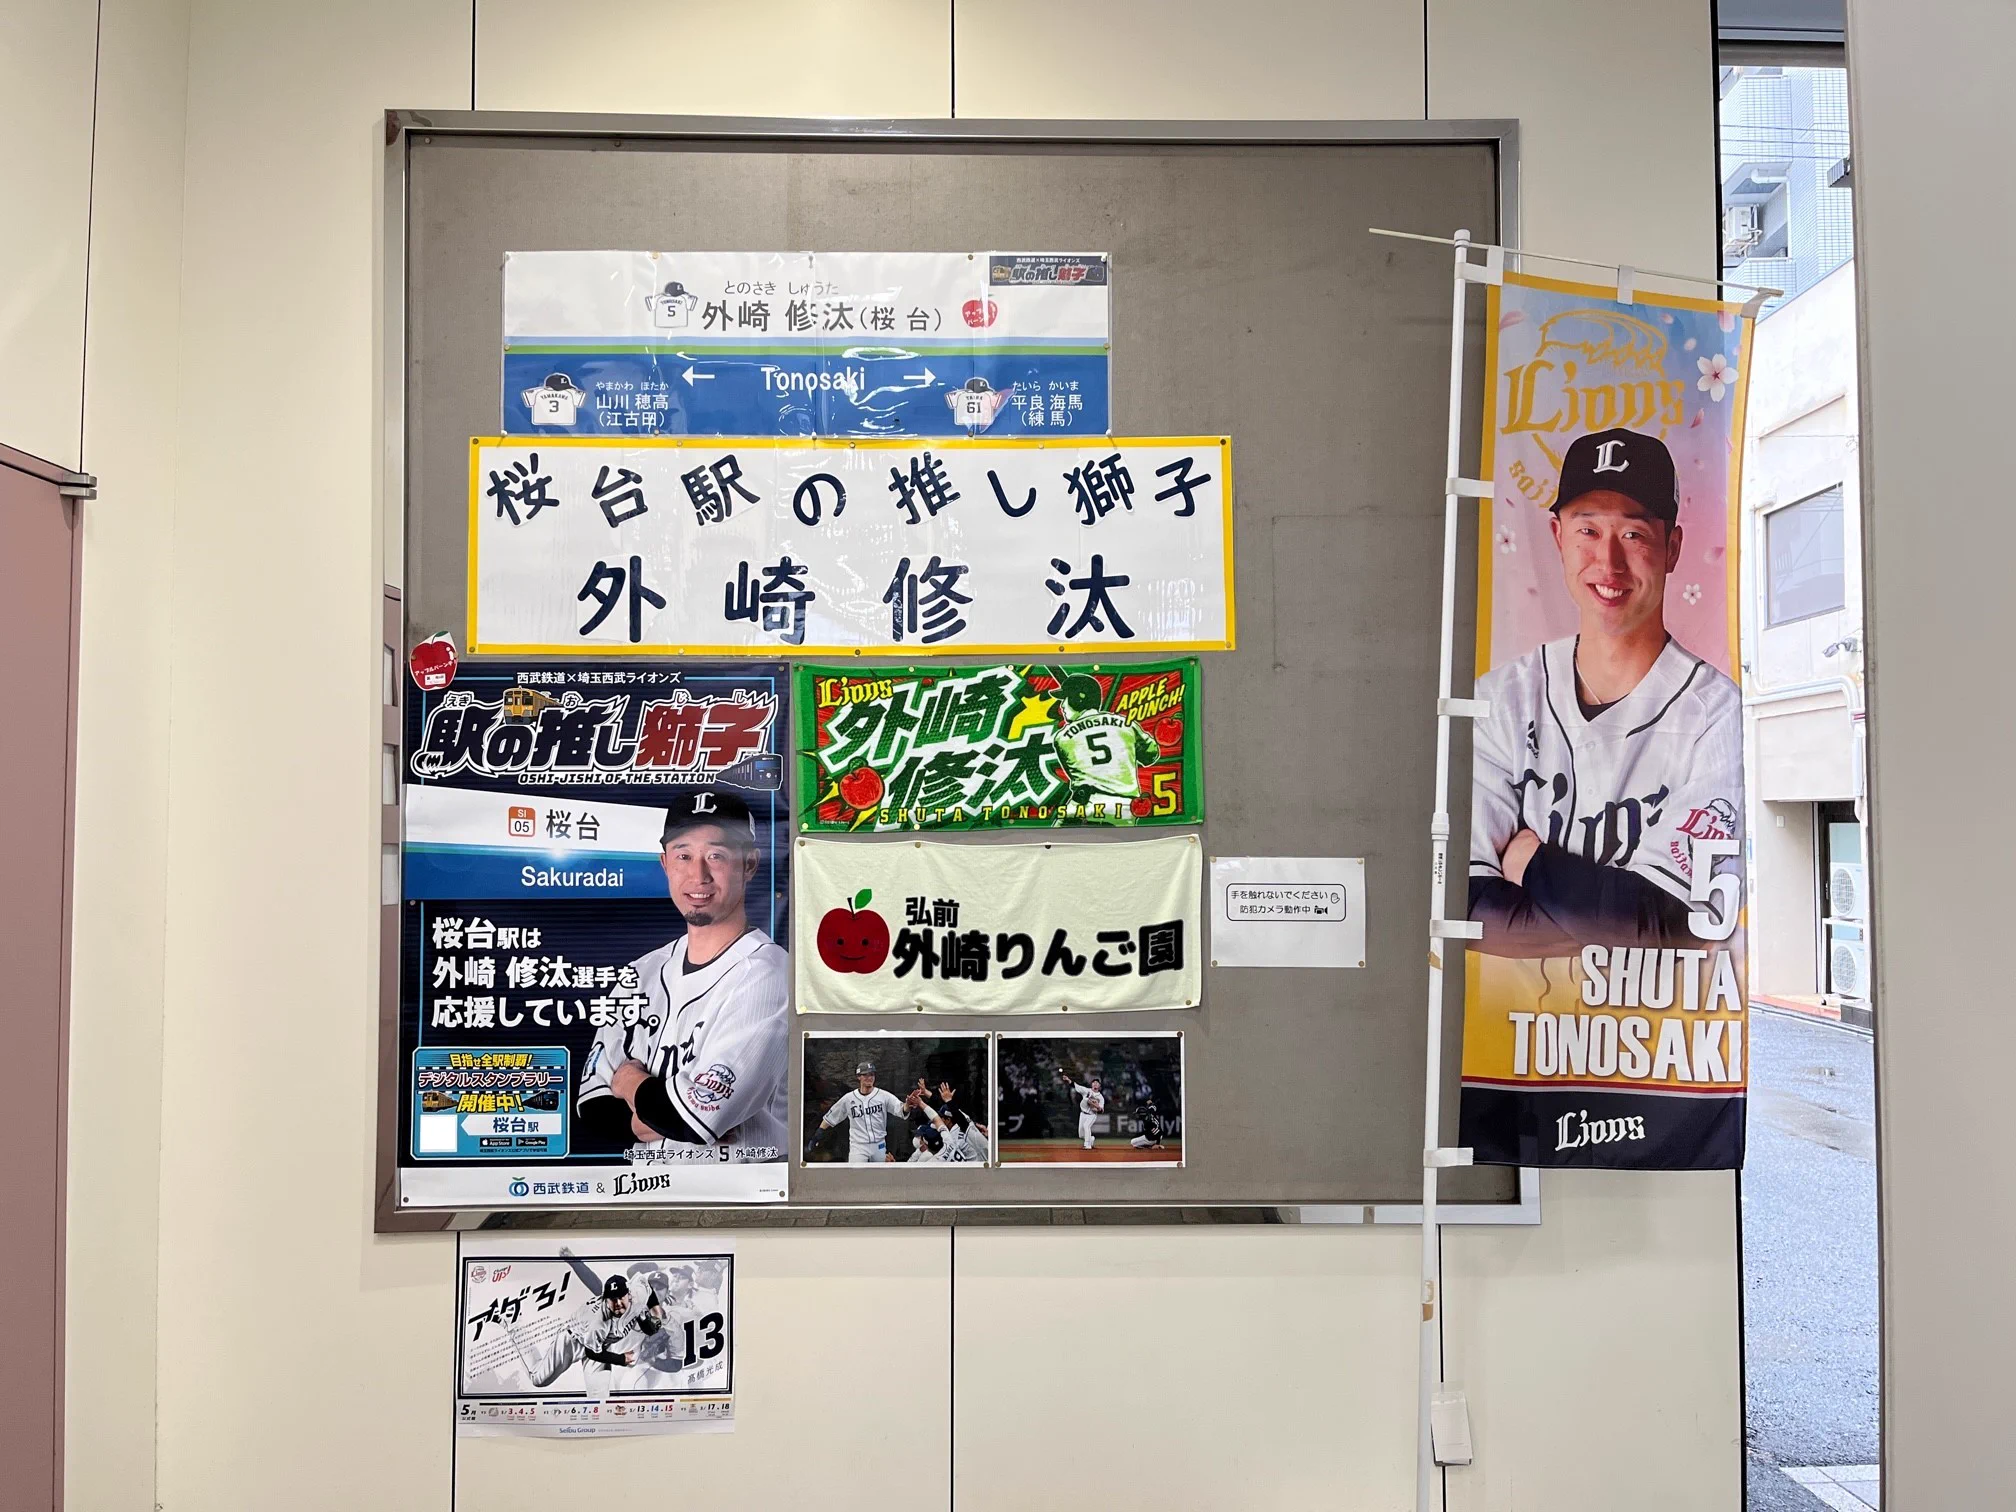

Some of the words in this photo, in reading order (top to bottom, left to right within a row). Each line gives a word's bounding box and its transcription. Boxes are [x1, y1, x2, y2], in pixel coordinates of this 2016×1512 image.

[724, 281, 776, 295] とのさき
[788, 281, 839, 295] しゅうた
[667, 305, 676, 318] 5
[701, 299, 771, 332] 外崎
[595, 382, 634, 391] やまかわ
[640, 382, 669, 391] ほたか
[760, 367, 865, 391] Tonosaki
[1012, 380, 1042, 392] たいら
[1048, 380, 1080, 392] かいま
[549, 401, 559, 413] 3
[596, 394, 629, 410] 山川
[635, 394, 669, 410] 穂高
[966, 402, 982, 414] 61
[1011, 394, 1044, 411] 平良
[1049, 394, 1083, 411] 海馬
[1500, 360, 1685, 435] Lions
[599, 411, 665, 427] （江古田）
[1592, 440, 1630, 473] L
[486, 452, 1212, 528] 桜台駅の推し獅子
[516, 671, 682, 685] 西武鉄道×埼玉西武ライオンズ
[446, 697, 471, 707] えき
[563, 694, 578, 708] お
[735, 693, 746, 704] し
[818, 676, 894, 709] Lions
[1116, 677, 1167, 713] APPLE
[1126, 685, 1185, 726] PUNCH!
[826, 672, 1018, 768] 外崎
[1063, 711, 1125, 739] TONOSAKI
[425, 702, 774, 771] 駅の推し獅子
[1085, 732, 1113, 766] 5
[518, 773, 602, 785] OSHI-JISHI
[604, 773, 622, 785] OF
[624, 773, 651, 785] THE
[652, 773, 716, 785] STATION
[888, 731, 1061, 823] 修汰
[692, 791, 718, 815] L
[1152, 771, 1178, 816] 5
[517, 809, 527, 818] SI
[545, 808, 602, 841] 桜台
[880, 804, 964, 824] SHUTA
[982, 803, 1122, 820] TONOSAKI
[513, 821, 530, 834] 05
[521, 865, 624, 889] Sakuradai
[1231, 890, 1328, 900] 手を触れないでください
[1687, 839, 1740, 940] 5
[905, 897, 960, 928] 弘前
[1240, 905, 1311, 914] 防犯カメラ動作中
[432, 917, 542, 950] 桜台駅は
[892, 919, 1184, 982] 外崎りんご園
[432, 956, 496, 989] 外崎
[506, 956, 639, 989] 修汰選手を
[1581, 944, 1742, 1011] SHUTA
[431, 995, 661, 1029] 応援しています。
[1509, 1012, 1742, 1082] TONOSAKI
[449, 1053, 533, 1067] 目指せ全駅制覇!
[419, 1071, 564, 1088] デジタルスタンプラリー
[456, 1094, 525, 1113] 開催中!
[850, 1103, 883, 1119] Lions
[492, 1116, 539, 1133] 桜台駅
[1554, 1109, 1646, 1152] Lions
[623, 1148, 714, 1161] 埼玉西武ライオンズ
[719, 1145, 729, 1162] 5
[735, 1147, 779, 1160] 外崎修汰
[533, 1182, 589, 1195] 西武鉄道
[596, 1182, 605, 1194] &
[613, 1172, 671, 1197] Lions
[683, 1312, 725, 1368] 13
